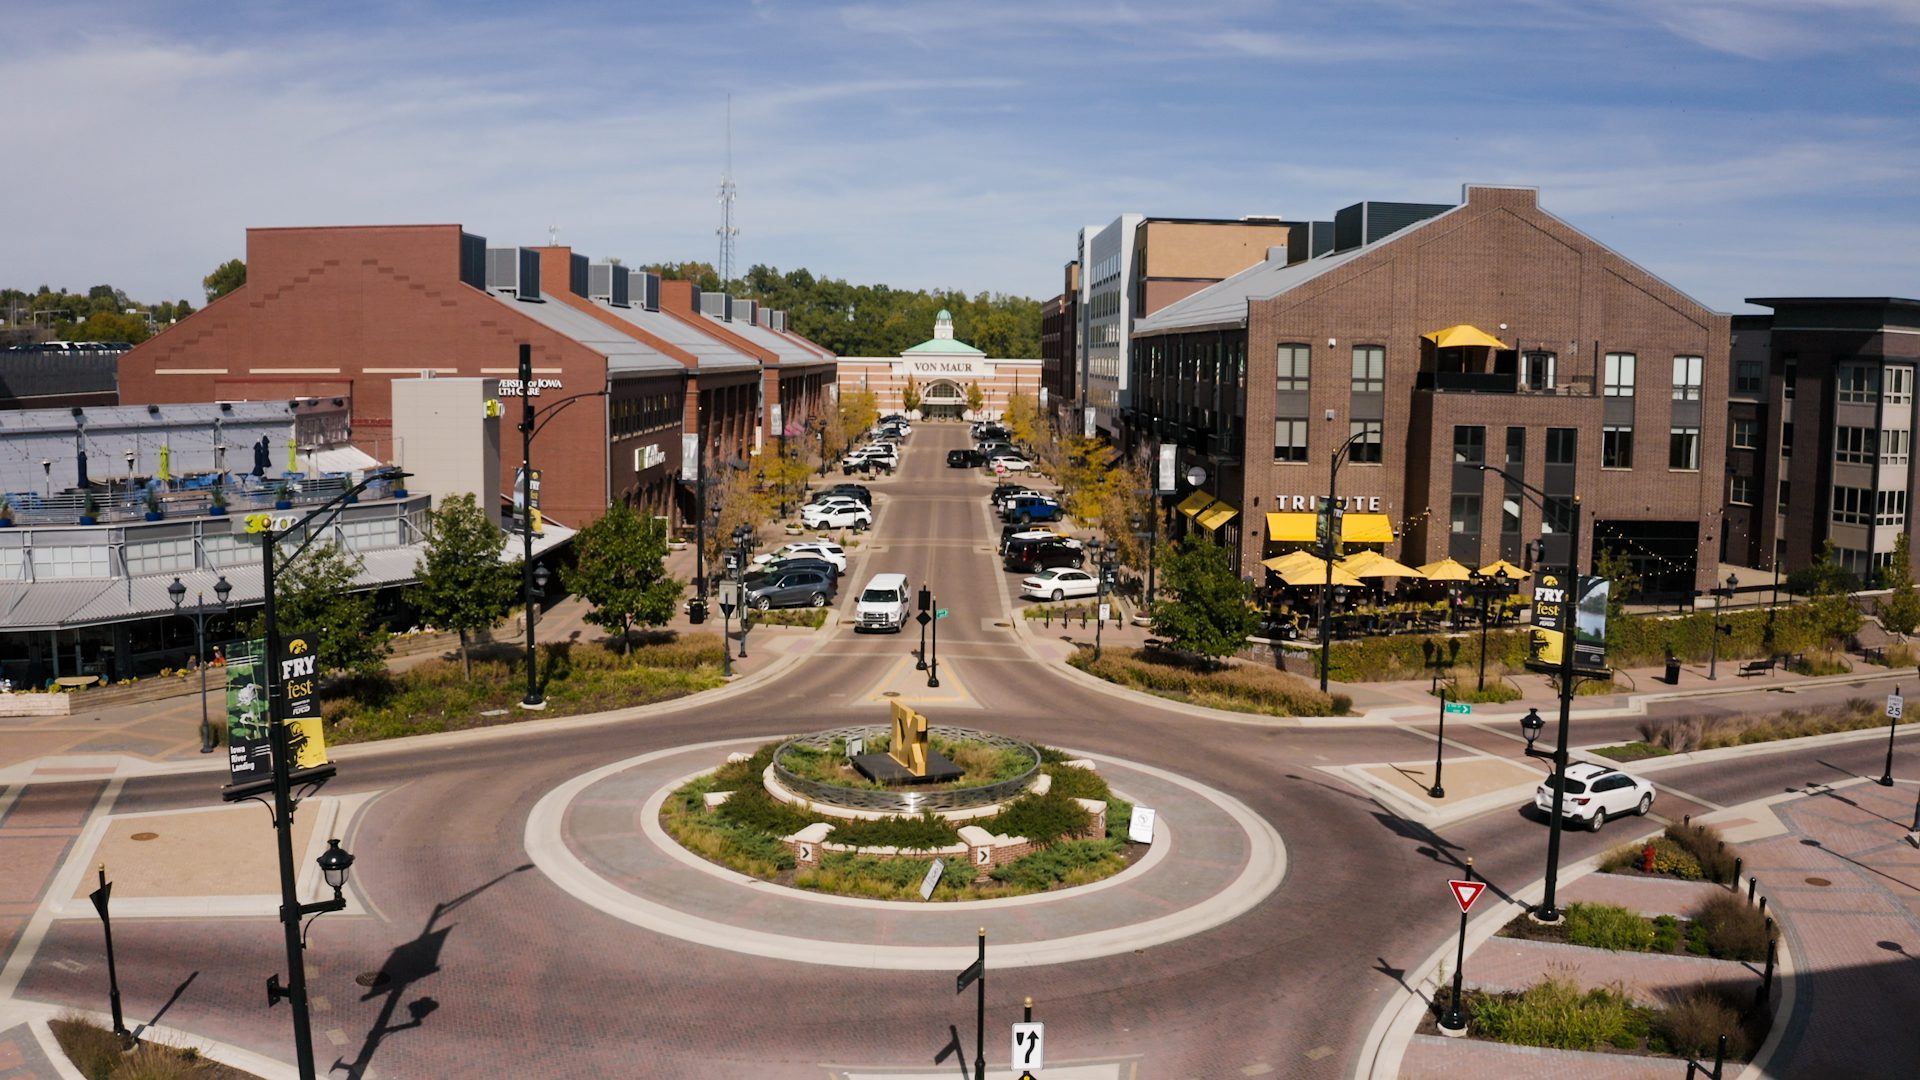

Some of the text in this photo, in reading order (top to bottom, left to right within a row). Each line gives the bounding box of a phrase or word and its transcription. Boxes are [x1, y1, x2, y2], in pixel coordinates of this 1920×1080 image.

[915, 363, 972, 372] VON MAUR
[538, 379, 562, 388] IOWA
[1534, 587, 1564, 602] FRY
[1537, 601, 1560, 616] fest
[282, 655, 316, 680] FRY
[287, 679, 313, 699] fest
[1888, 706, 1900, 716] 25
